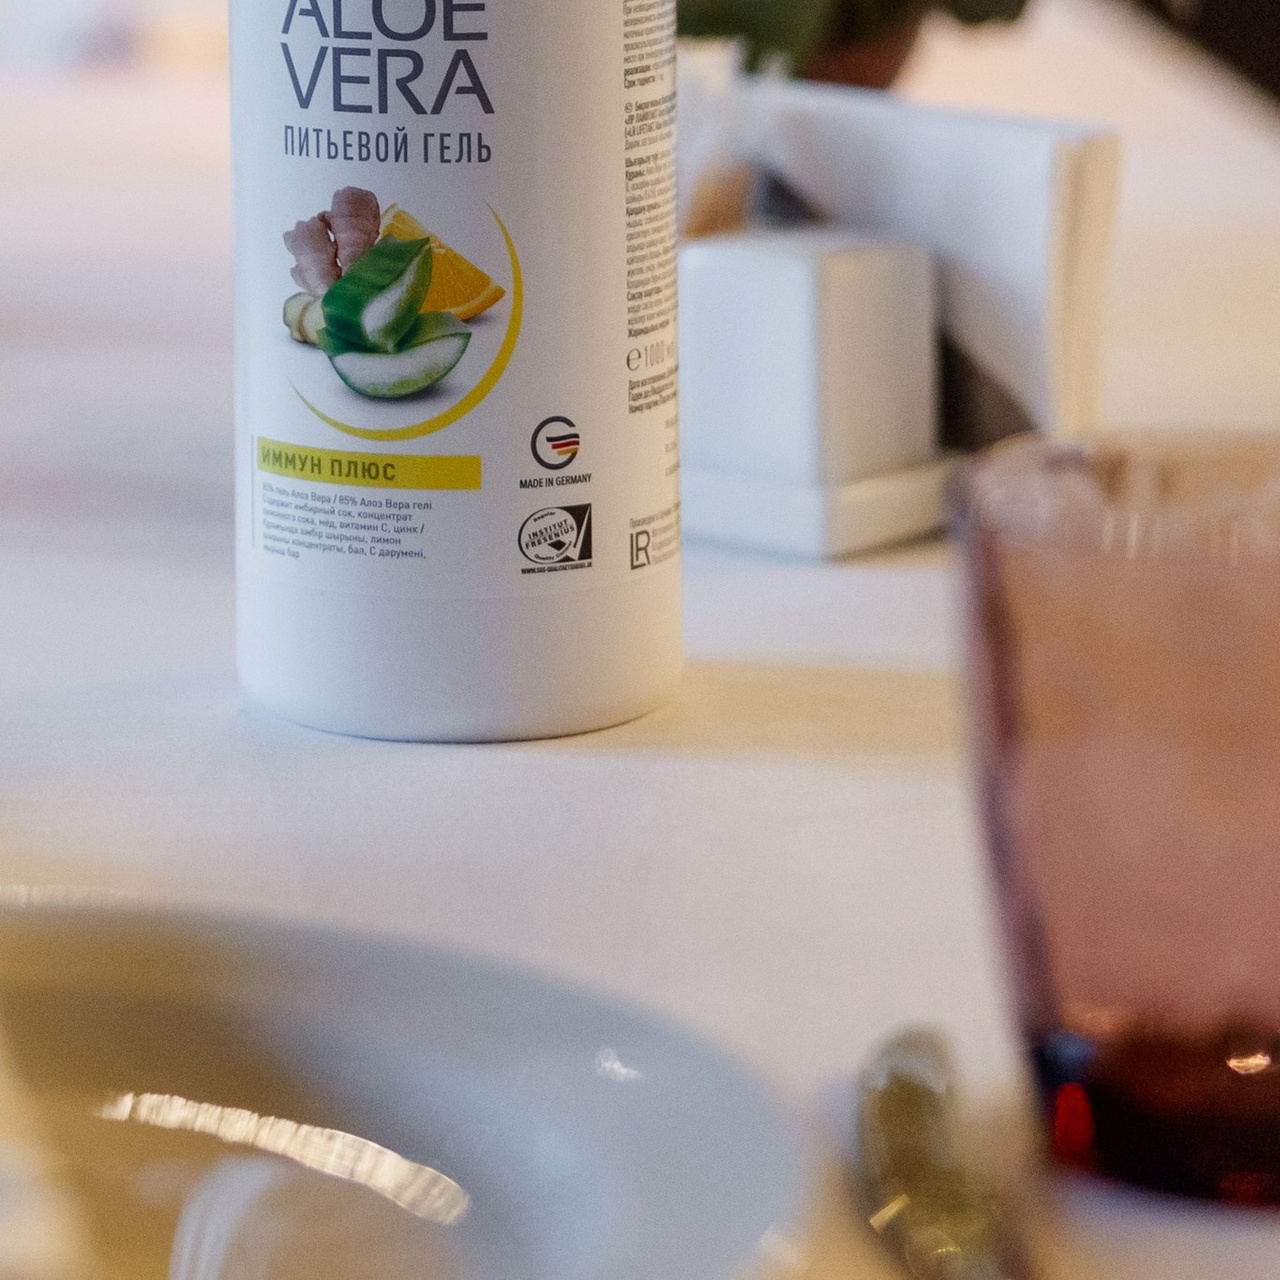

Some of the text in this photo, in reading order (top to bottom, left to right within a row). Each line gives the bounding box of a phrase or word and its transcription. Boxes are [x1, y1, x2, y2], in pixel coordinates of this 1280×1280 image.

[280, 42, 495, 115] VERA
[284, 125, 492, 163] ПИТЬЕВОЙ ГЕЛЬ
[262, 447, 396, 481] ИММУН ПЛЮС
[519, 473, 592, 489] MADE IN GERMANY
[291, 489, 309, 500] Алоэ
[311, 491, 331, 504] Вера
[333, 494, 337, 504] /
[339, 495, 358, 506] 85%
[360, 497, 383, 508] Алоэ
[385, 498, 410, 511] Вера
[413, 500, 432, 510] гелі
[294, 503, 335, 515] имбирный
[338, 509, 355, 518] сок,
[358, 511, 412, 523] концентрат
[340, 521, 378, 532] витамин
[393, 526, 418, 534] цинк
[420, 523, 425, 534] /
[525, 525, 575, 550] FRESENIUS
[528, 519, 567, 540] INSTITUT
[325, 532, 368, 544] шырыны,
[370, 536, 401, 545] лимон
[348, 543, 367, 556] бал,
[369, 546, 376, 556] С
[630, 530, 651, 570] LR
